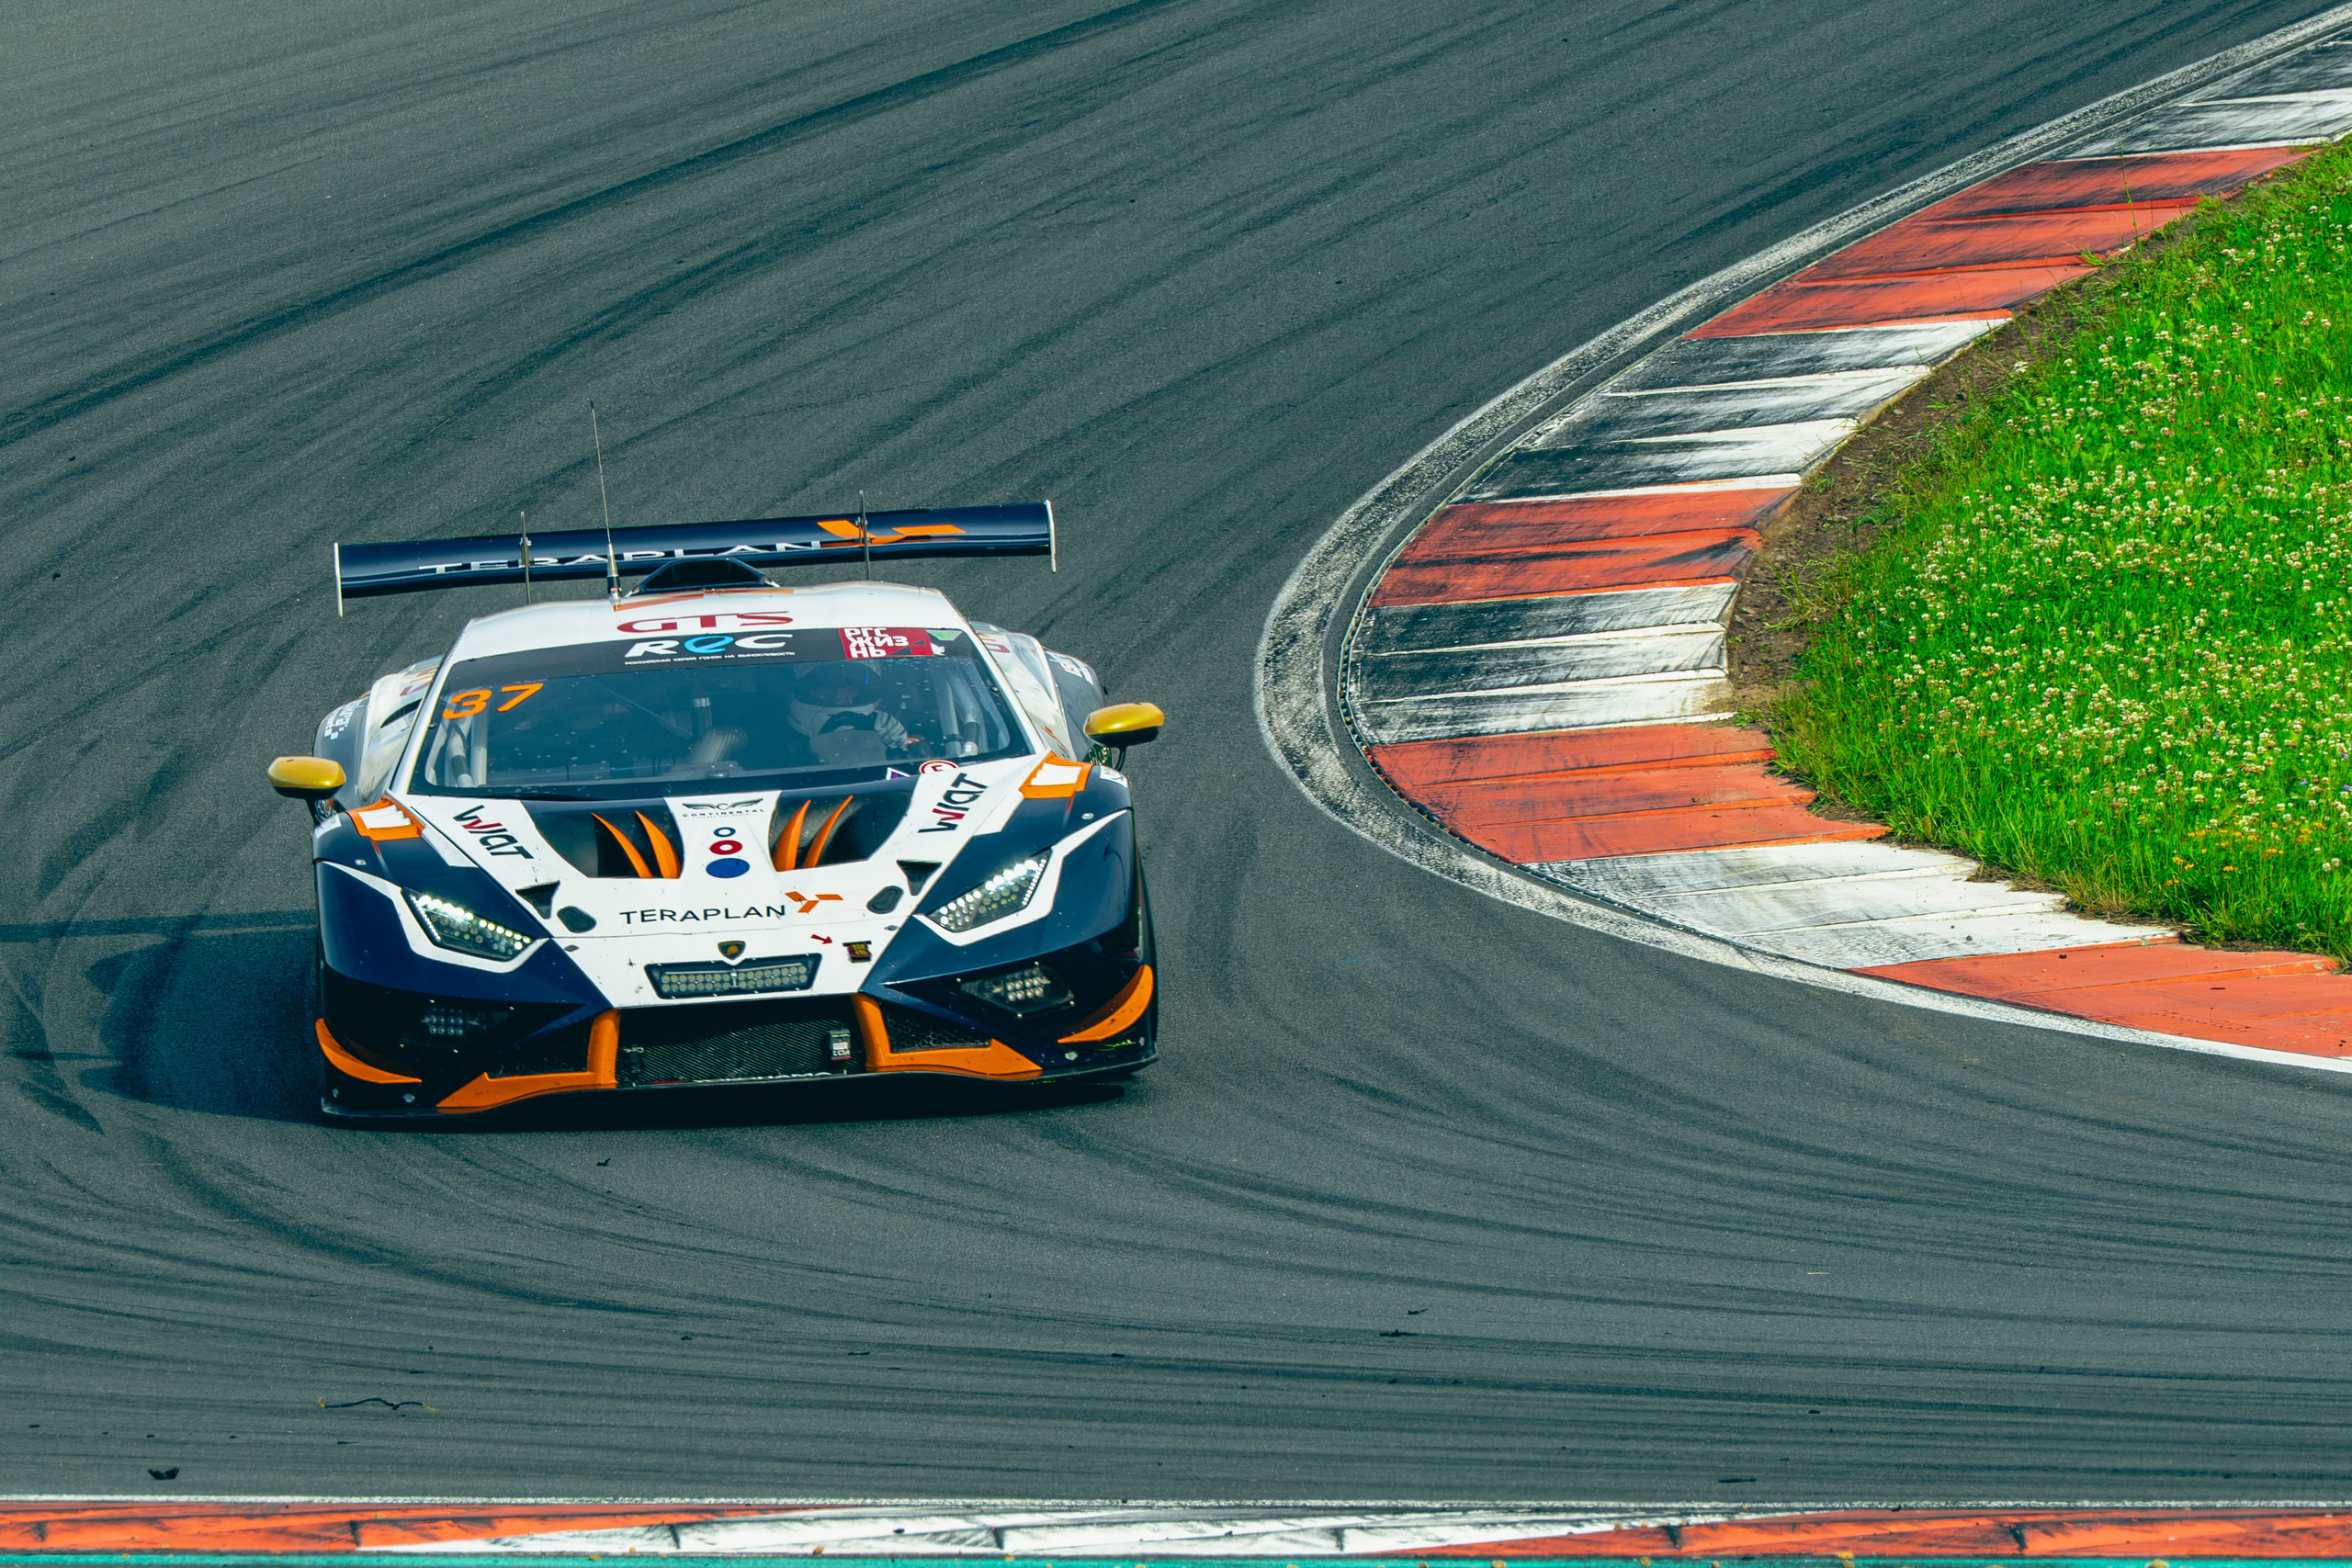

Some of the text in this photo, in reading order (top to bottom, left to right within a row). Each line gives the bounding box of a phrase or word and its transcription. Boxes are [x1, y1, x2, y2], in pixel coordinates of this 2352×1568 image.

[418, 540, 820, 574] TERAPLAN
[616, 610, 794, 634] GTS
[843, 627, 889, 637] РГС
[442, 682, 545, 720] 37
[682, 807, 765, 818] CONTINENTAL
[618, 904, 786, 925] TERAPLAN
